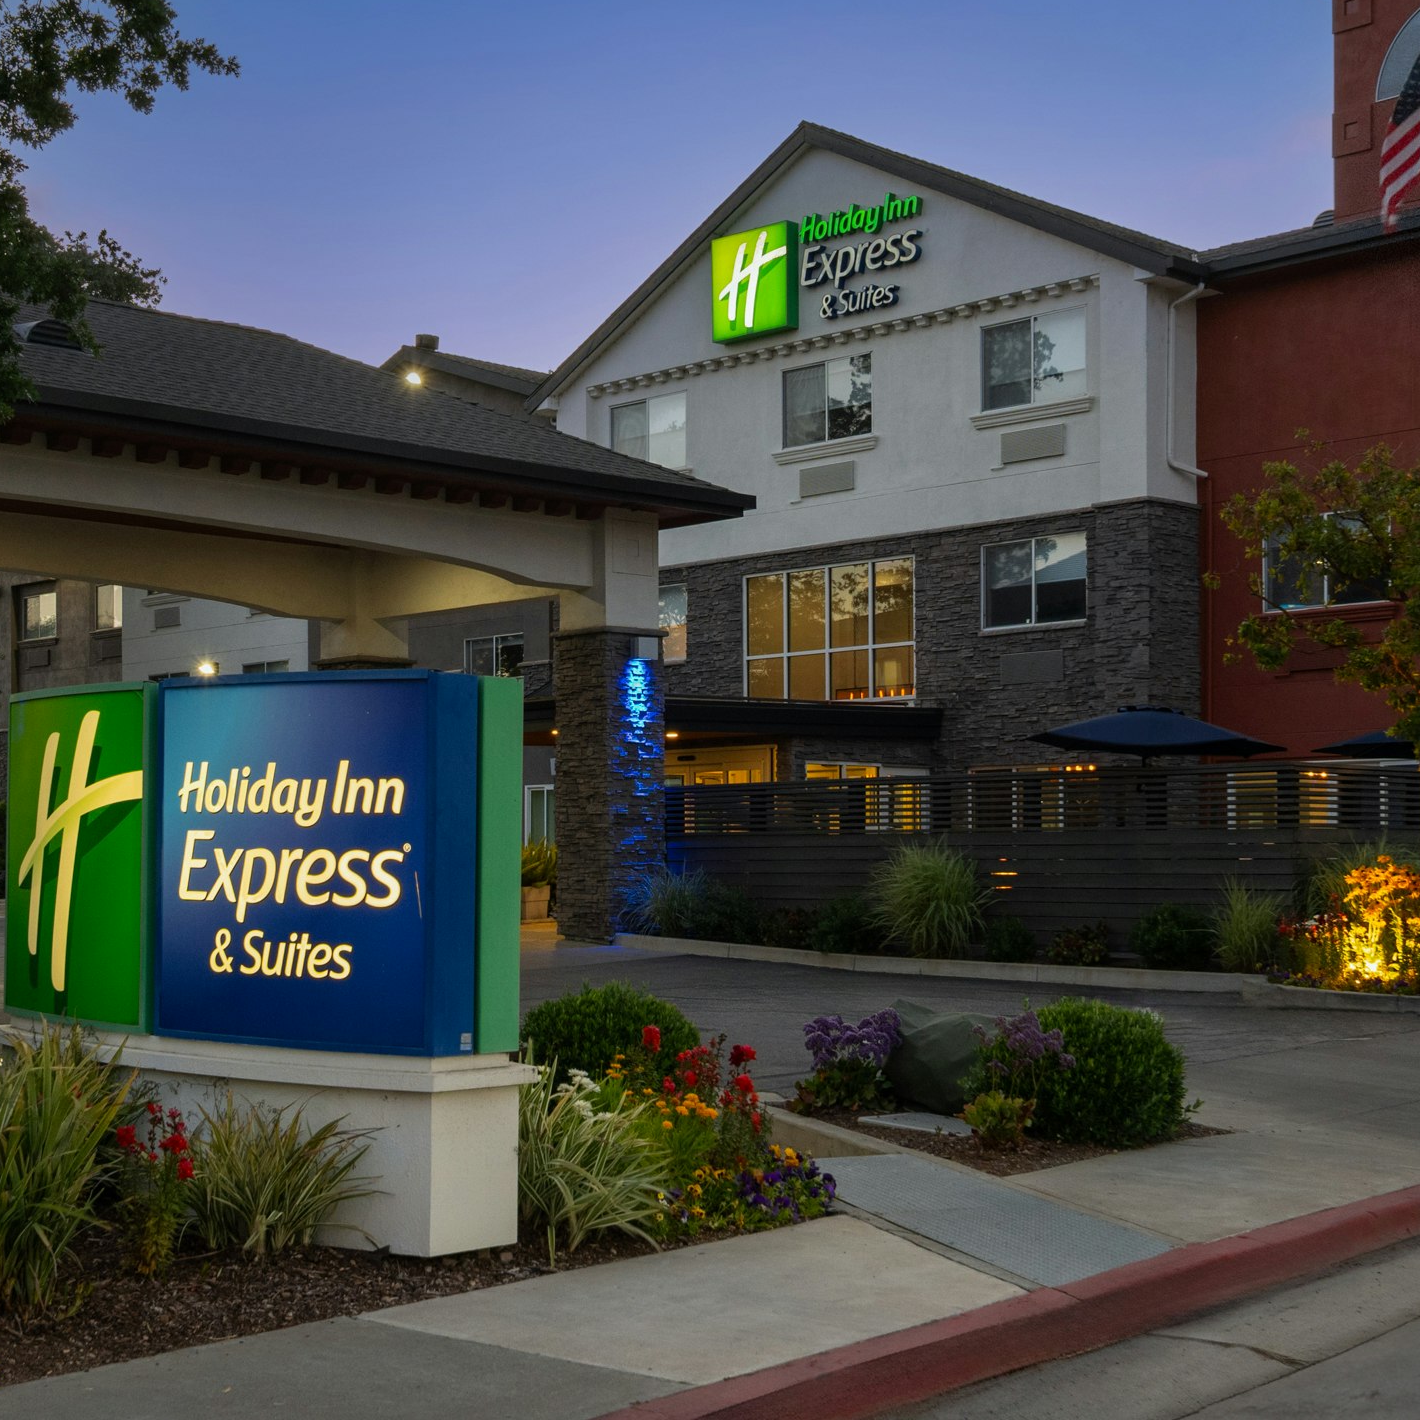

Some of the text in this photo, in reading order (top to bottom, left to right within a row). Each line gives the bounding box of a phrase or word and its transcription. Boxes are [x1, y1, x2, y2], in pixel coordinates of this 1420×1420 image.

[798, 192, 920, 244] Holiday Inn
[800, 228, 921, 289] Express
[819, 284, 898, 318] & Suites
[178, 759, 405, 827] Holiday Inn
[209, 927, 353, 980] & Suites
